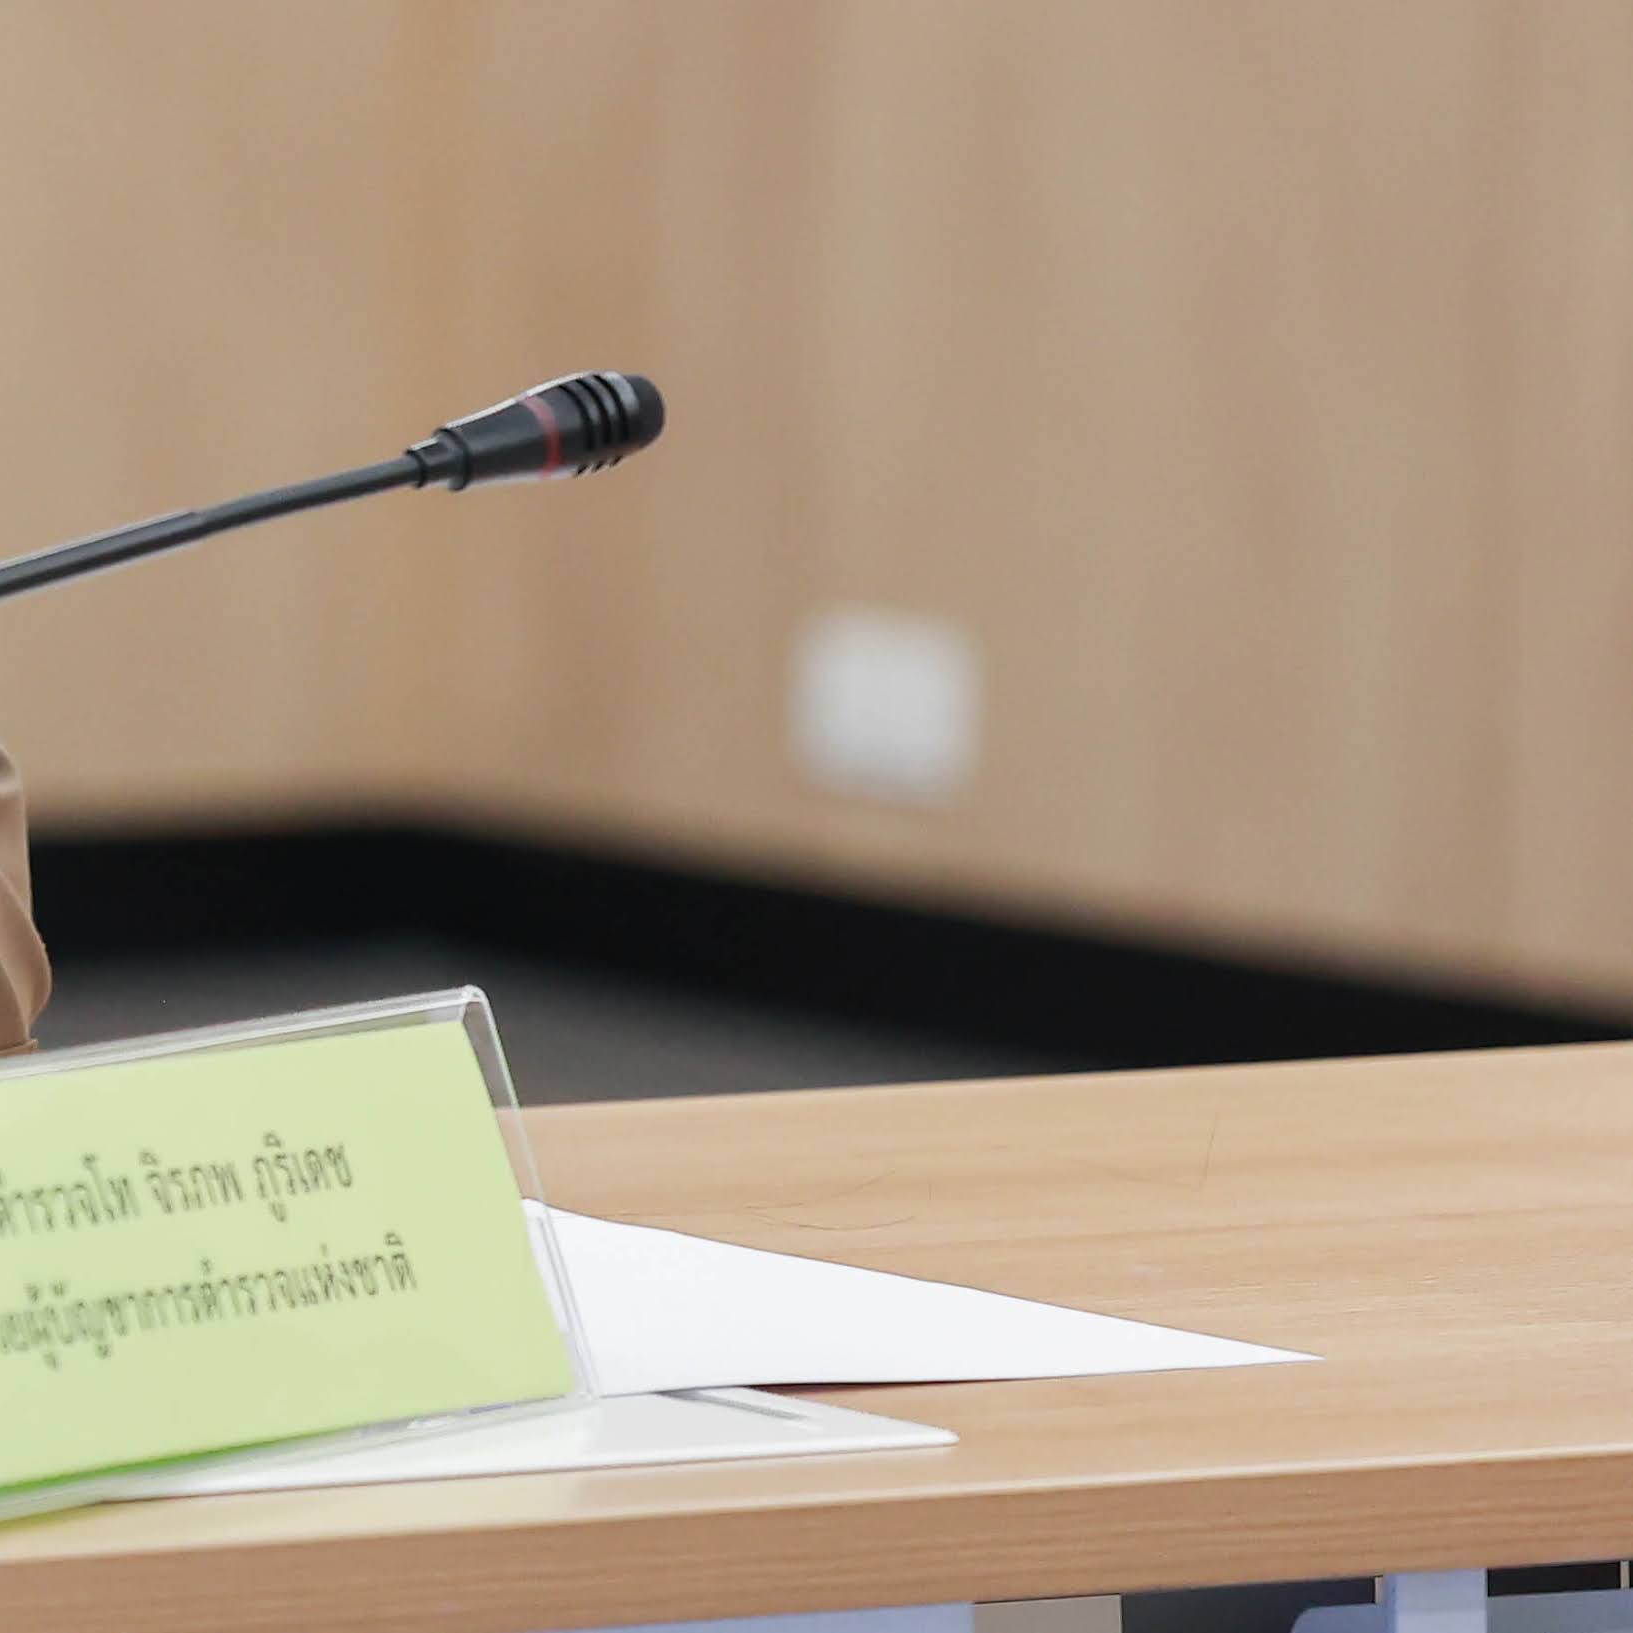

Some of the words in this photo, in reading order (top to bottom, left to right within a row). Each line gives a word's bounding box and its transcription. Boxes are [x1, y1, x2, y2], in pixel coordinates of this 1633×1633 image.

[140, 1149, 244, 1215] จิรภพ
[251, 1131, 354, 1222] ภูริเดช
